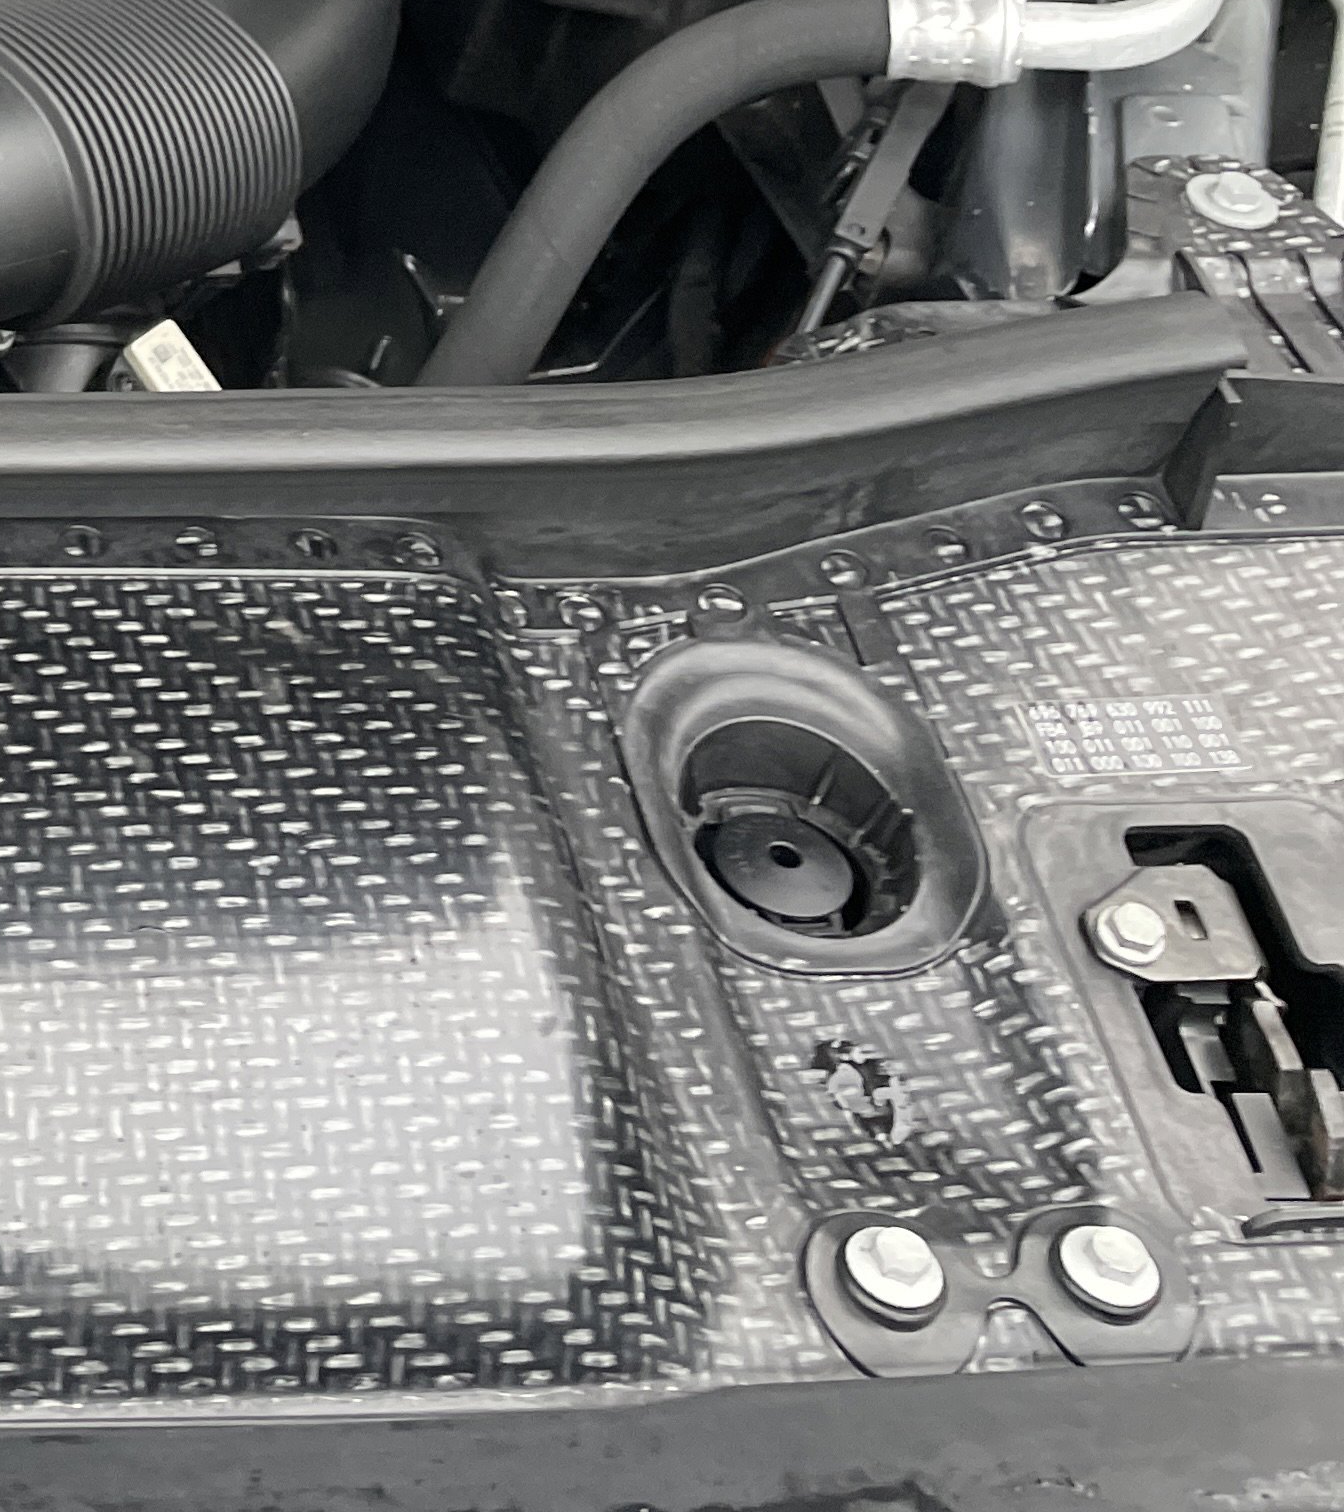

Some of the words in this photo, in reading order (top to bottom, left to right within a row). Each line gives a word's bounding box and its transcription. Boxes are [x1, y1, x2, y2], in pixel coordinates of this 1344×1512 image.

[1182, 699, 1213, 713] 111
[1113, 719, 1144, 735] 011
[1082, 738, 1115, 753] 011
[1052, 757, 1084, 773] 011
